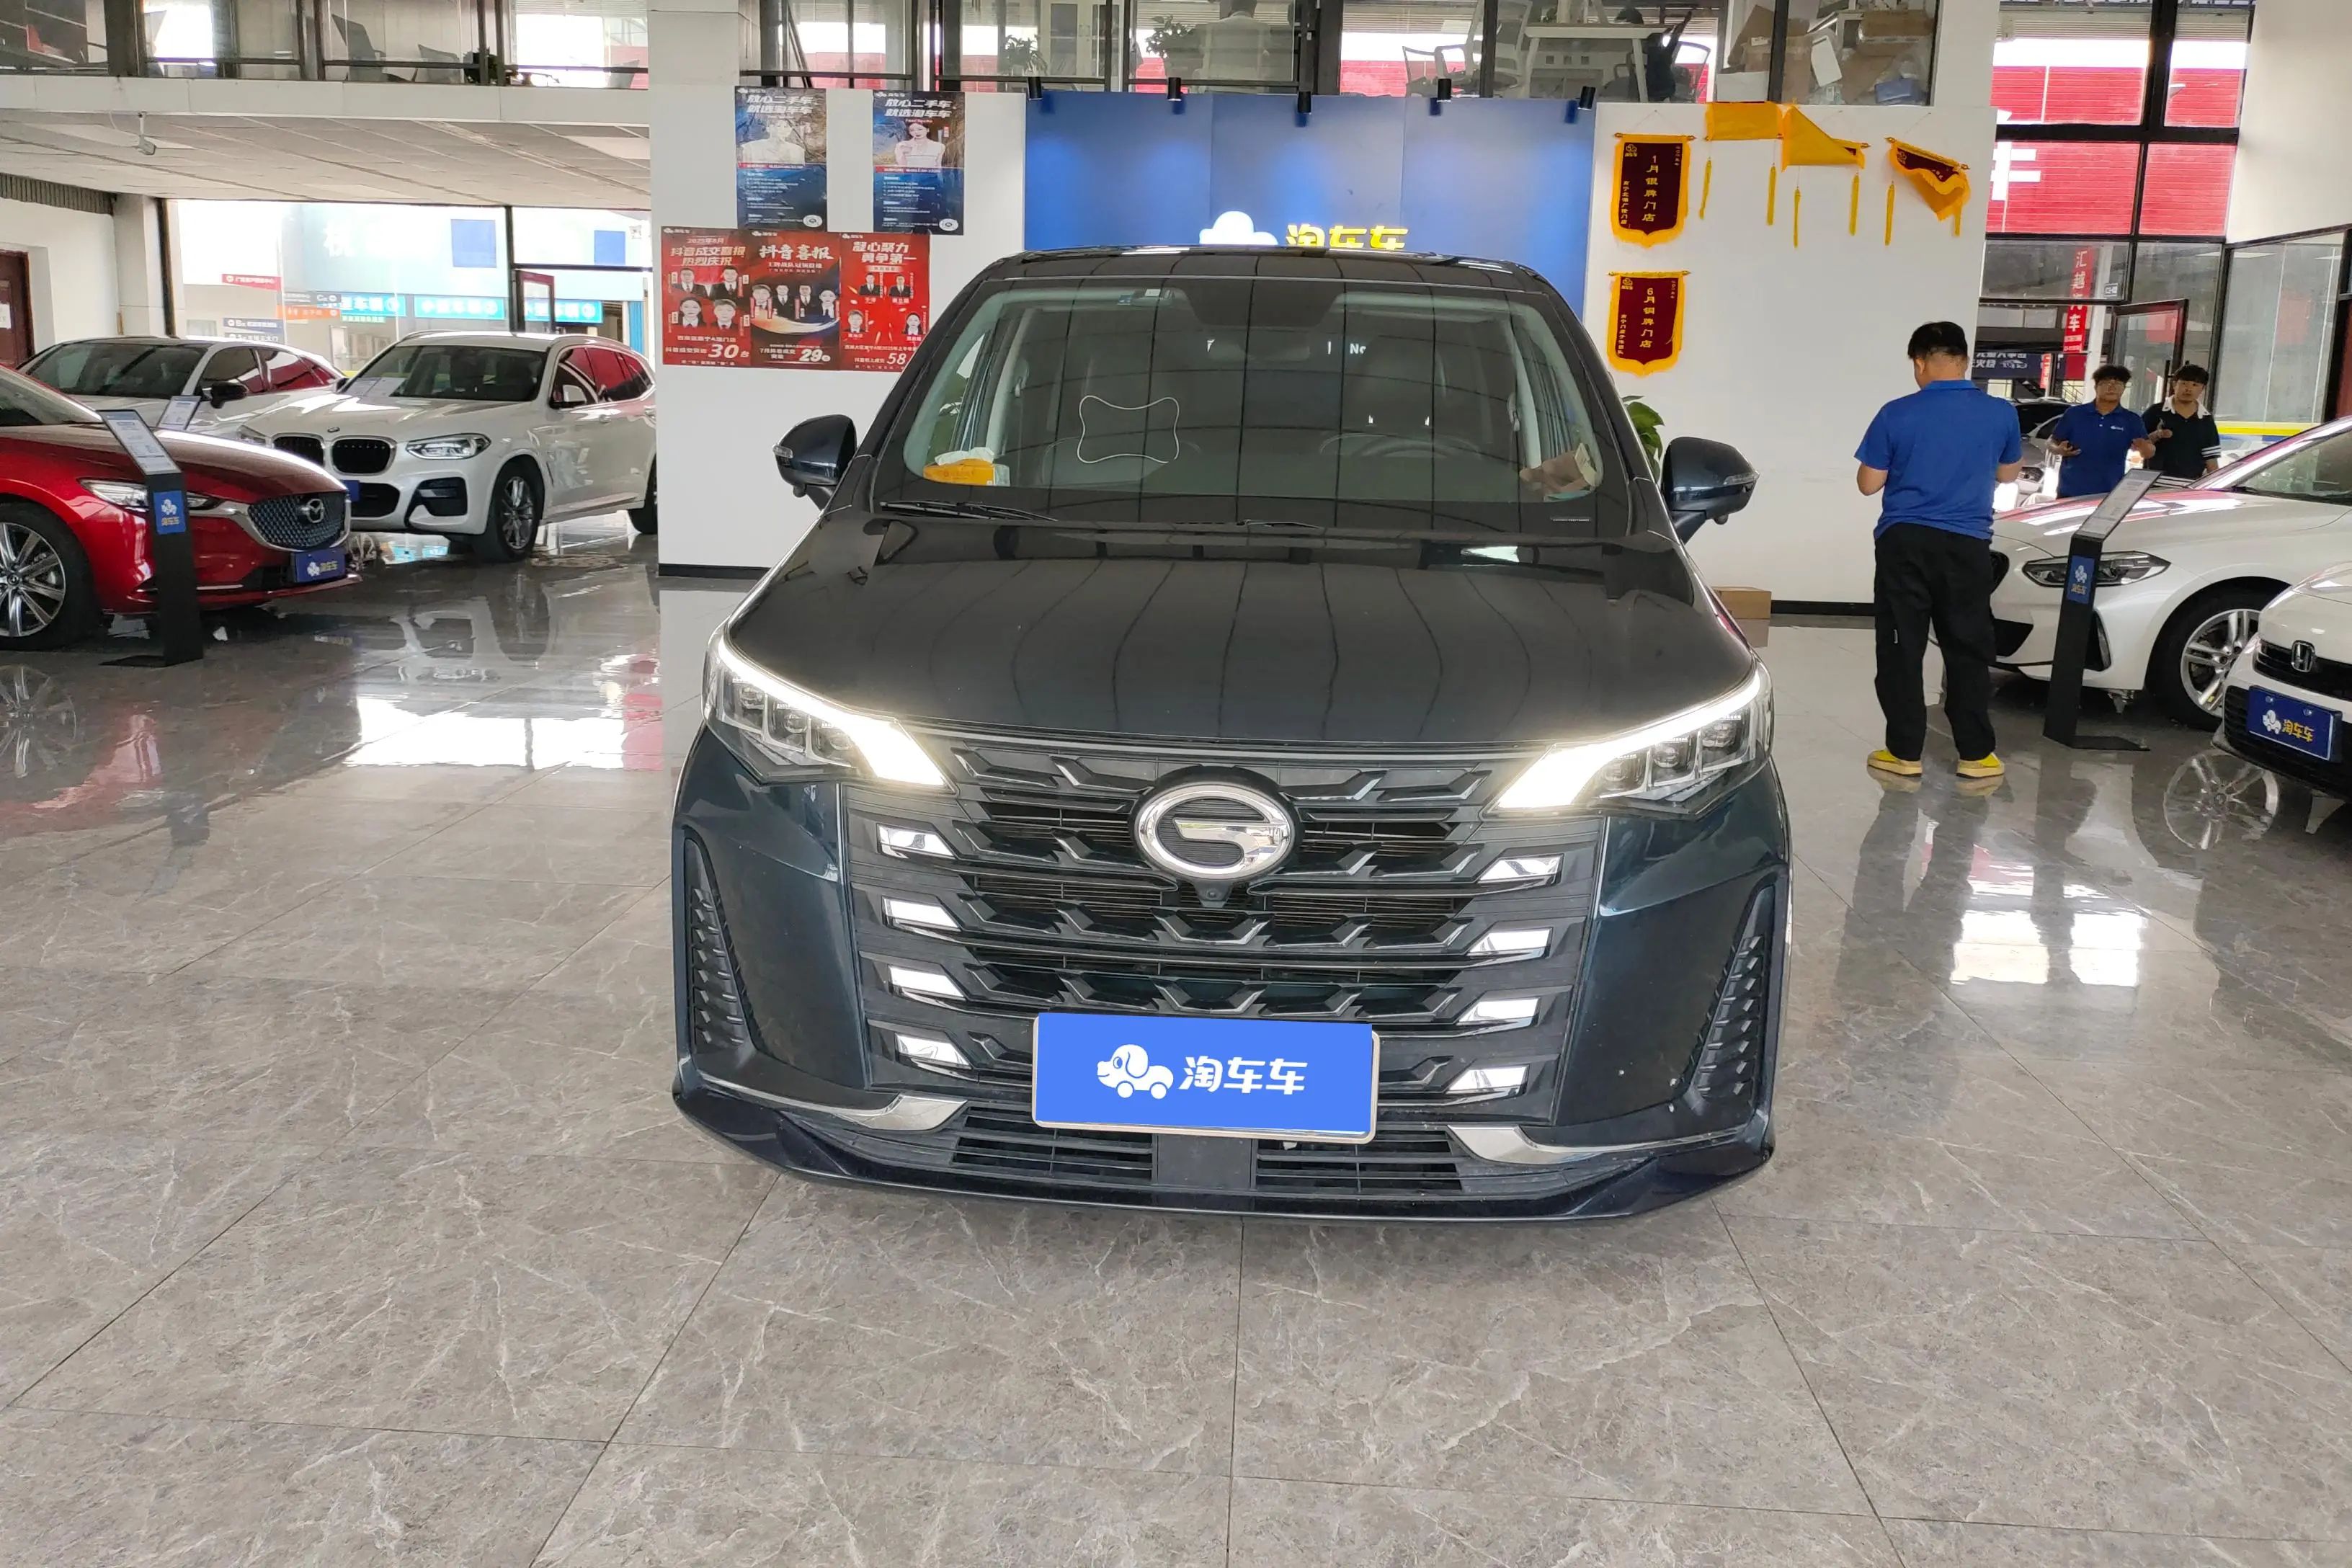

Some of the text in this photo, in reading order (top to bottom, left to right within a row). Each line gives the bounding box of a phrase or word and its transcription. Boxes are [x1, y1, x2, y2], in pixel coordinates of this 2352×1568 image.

[747, 95, 814, 104] 放心二手车
[885, 98, 953, 108] 放心二手车
[747, 105, 814, 115] 就选淘车车
[884, 109, 952, 119] 就选淘车车
[1642, 155, 1659, 222] 1月银牌门店
[1286, 223, 1408, 250] 淘车车
[670, 246, 746, 257] 抖音成交喜报
[759, 244, 834, 261] 抖音喜报
[852, 241, 909, 253] 凝心聚力
[682, 257, 733, 267] 热烈庆祝
[1639, 288, 1655, 348] 6月铜牌门店
[708, 344, 739, 358] 30
[799, 349, 822, 362] 29
[886, 353, 906, 365] 58
[2282, 718, 2315, 742] 淘车车
